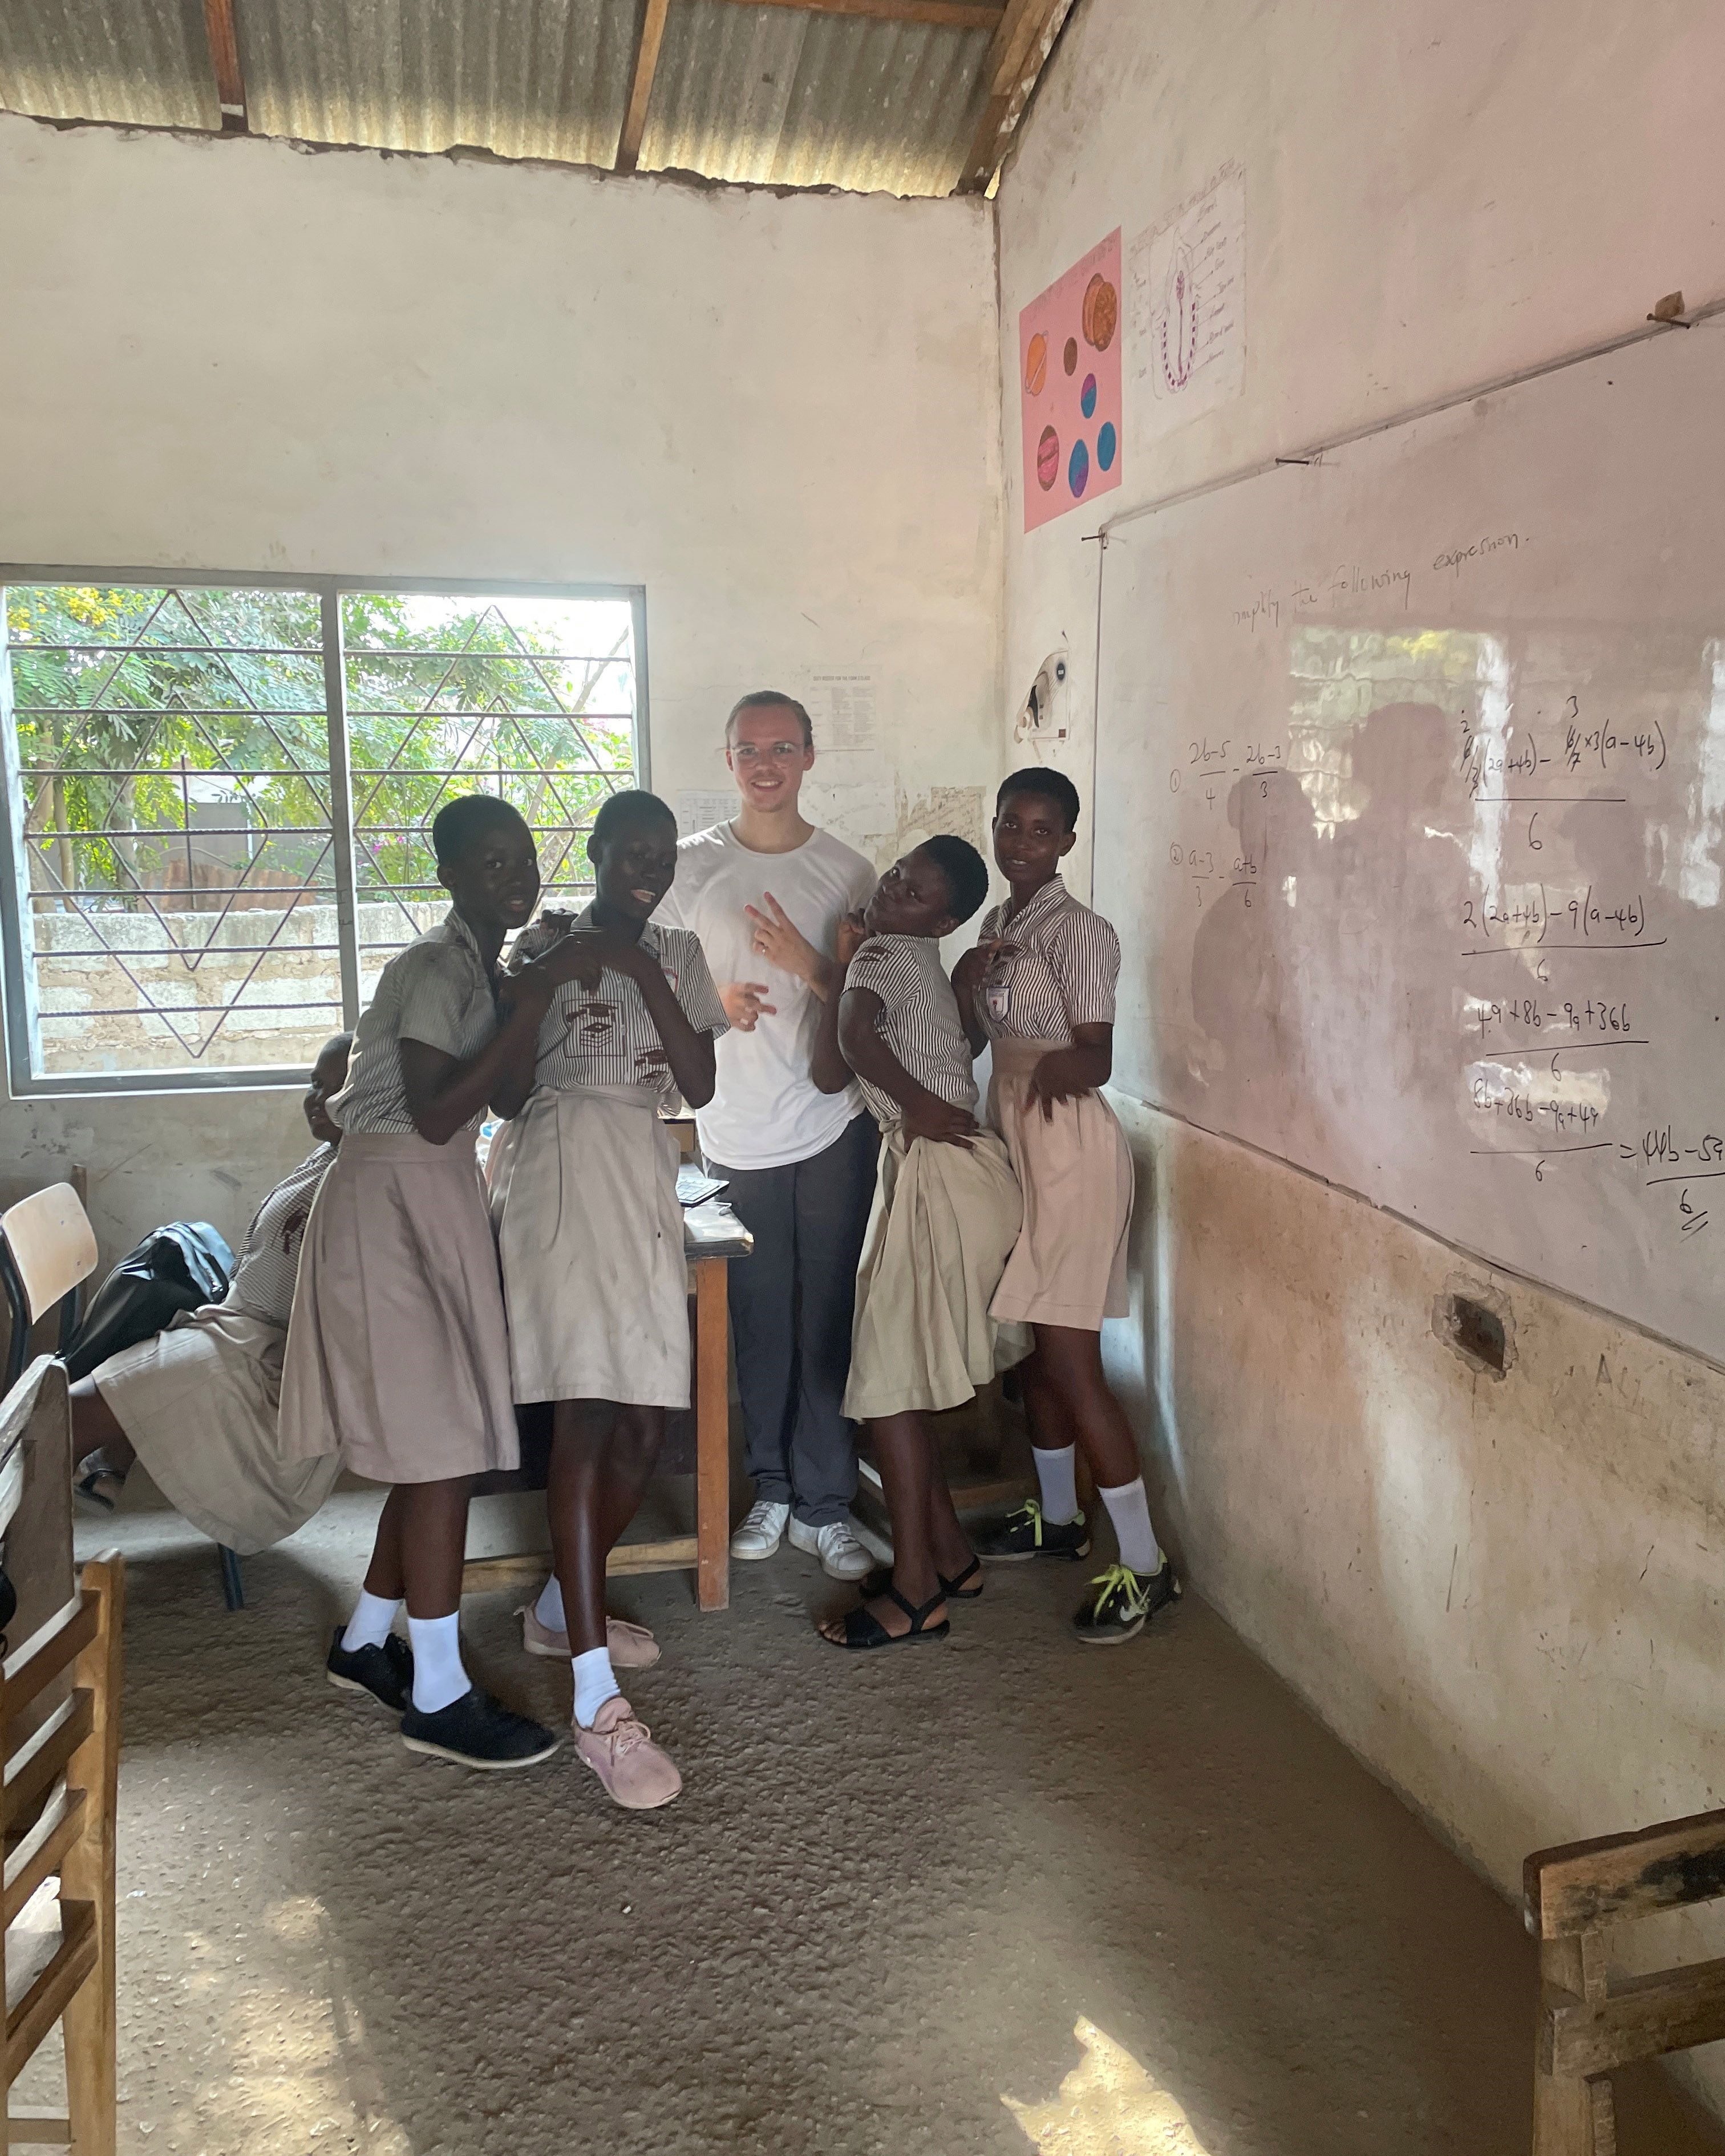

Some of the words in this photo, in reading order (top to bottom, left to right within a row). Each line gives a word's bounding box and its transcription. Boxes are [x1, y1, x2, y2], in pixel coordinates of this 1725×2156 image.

[1328, 564, 1411, 610] following
[1205, 787, 1216, 810] 4
[1260, 780, 1268, 799] 3
[1528, 812, 1542, 850] 6
[1244, 889, 1252, 908] 6
[1550, 1052, 1562, 1082] 6
[1535, 1160, 1545, 1182] 6
